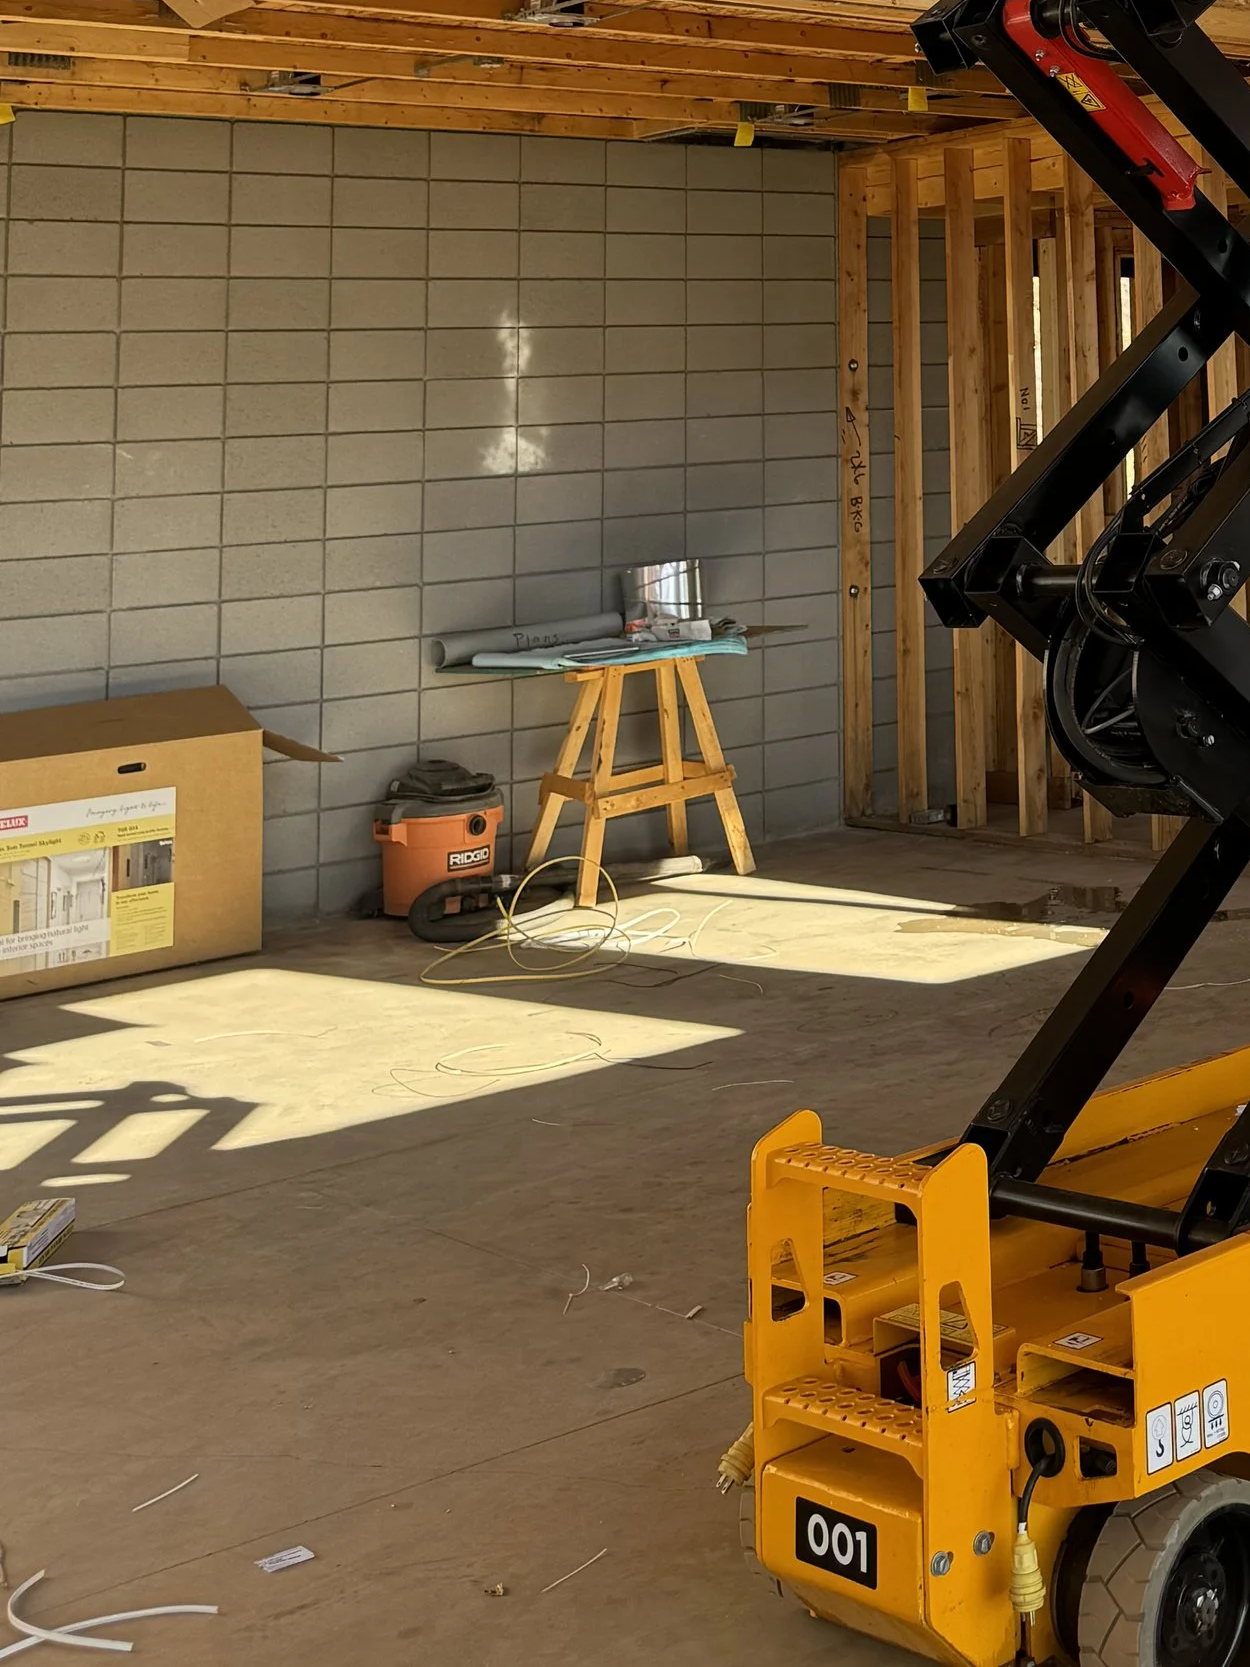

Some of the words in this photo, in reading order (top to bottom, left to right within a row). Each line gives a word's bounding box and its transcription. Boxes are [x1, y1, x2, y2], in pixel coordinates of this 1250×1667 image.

[449, 847, 489, 865] RIDGID
[73, 923, 89, 935] light
[807, 1513, 867, 1573] 001
